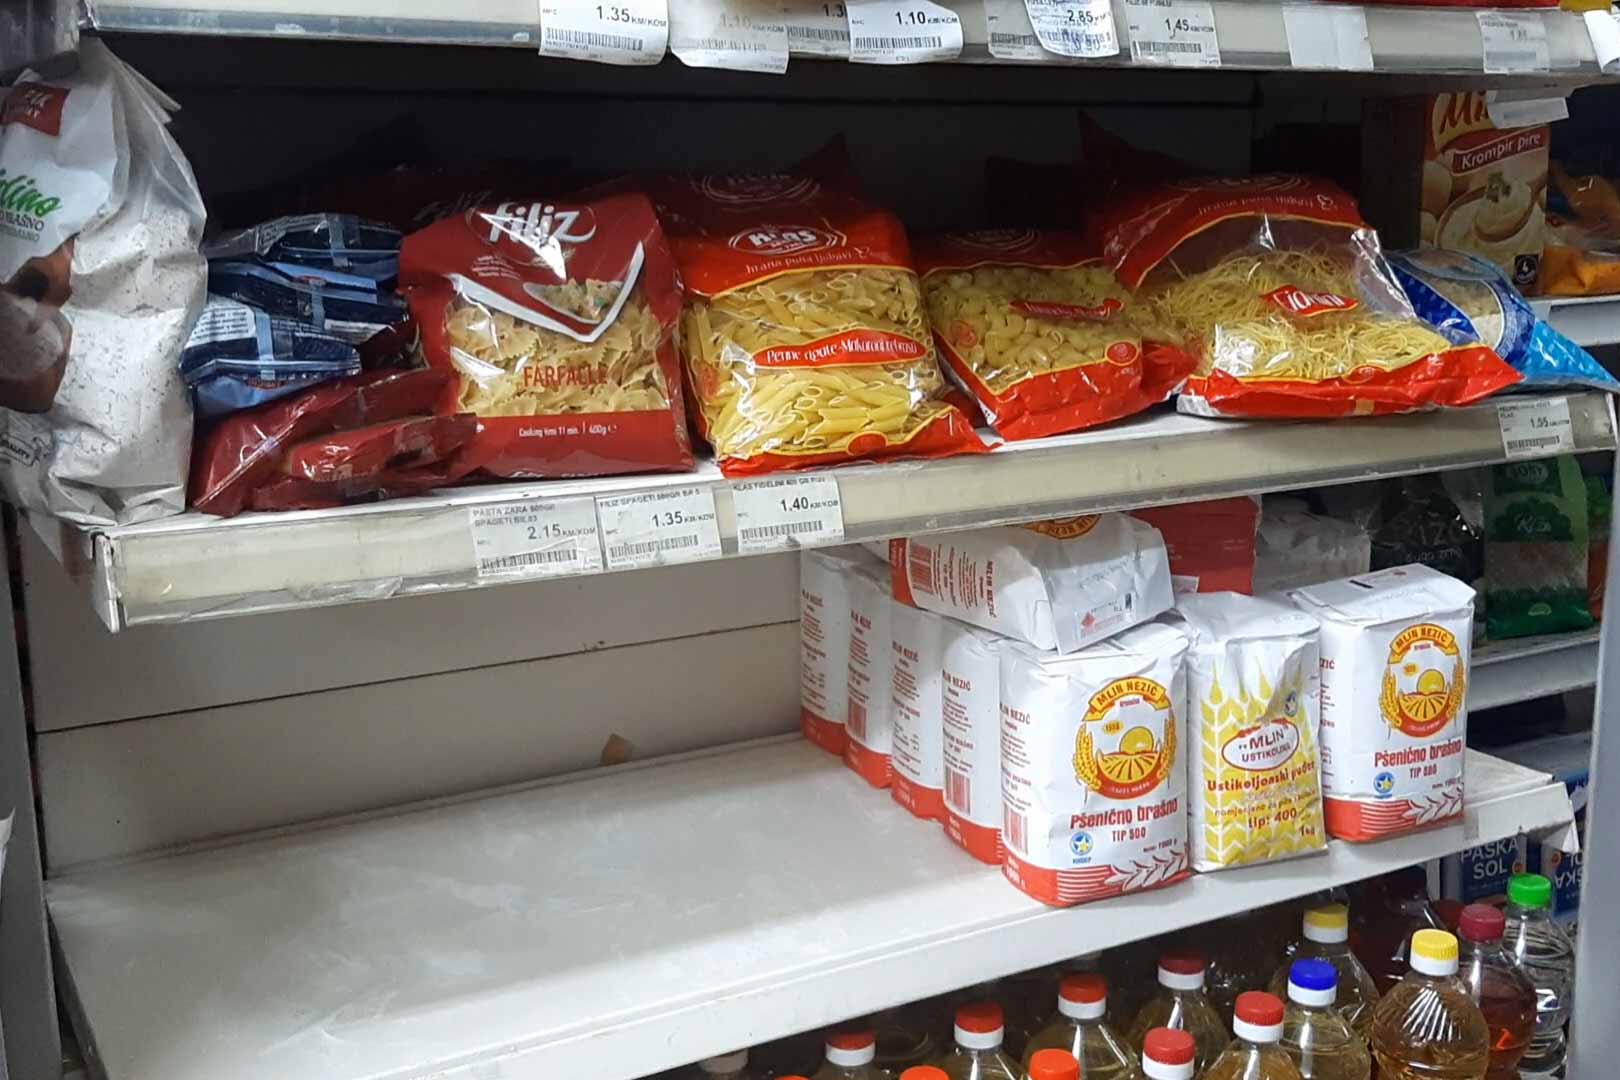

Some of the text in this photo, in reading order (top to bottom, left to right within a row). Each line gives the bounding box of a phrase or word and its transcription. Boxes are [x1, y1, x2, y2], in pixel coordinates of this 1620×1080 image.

[596, 5, 630, 23] 1.35
[823, 3, 848, 18] 1.3
[896, 11, 926, 25] 1.10
[1461, 133, 1541, 170] Krompir pire
[504, 505, 528, 515] ZARA
[780, 496, 809, 513] 1.40
[651, 511, 684, 528] 1.35
[526, 523, 561, 541] 2.15
[1096, 682, 1125, 707] MLIN
[1374, 739, 1463, 768] Pšenično brašno
[1070, 797, 1178, 830] Pšenično brašno
[1274, 807, 1297, 822] 400
[1112, 827, 1146, 842] TIP 500
[1460, 836, 1520, 865] PASKA
[1472, 858, 1508, 881] SOL
